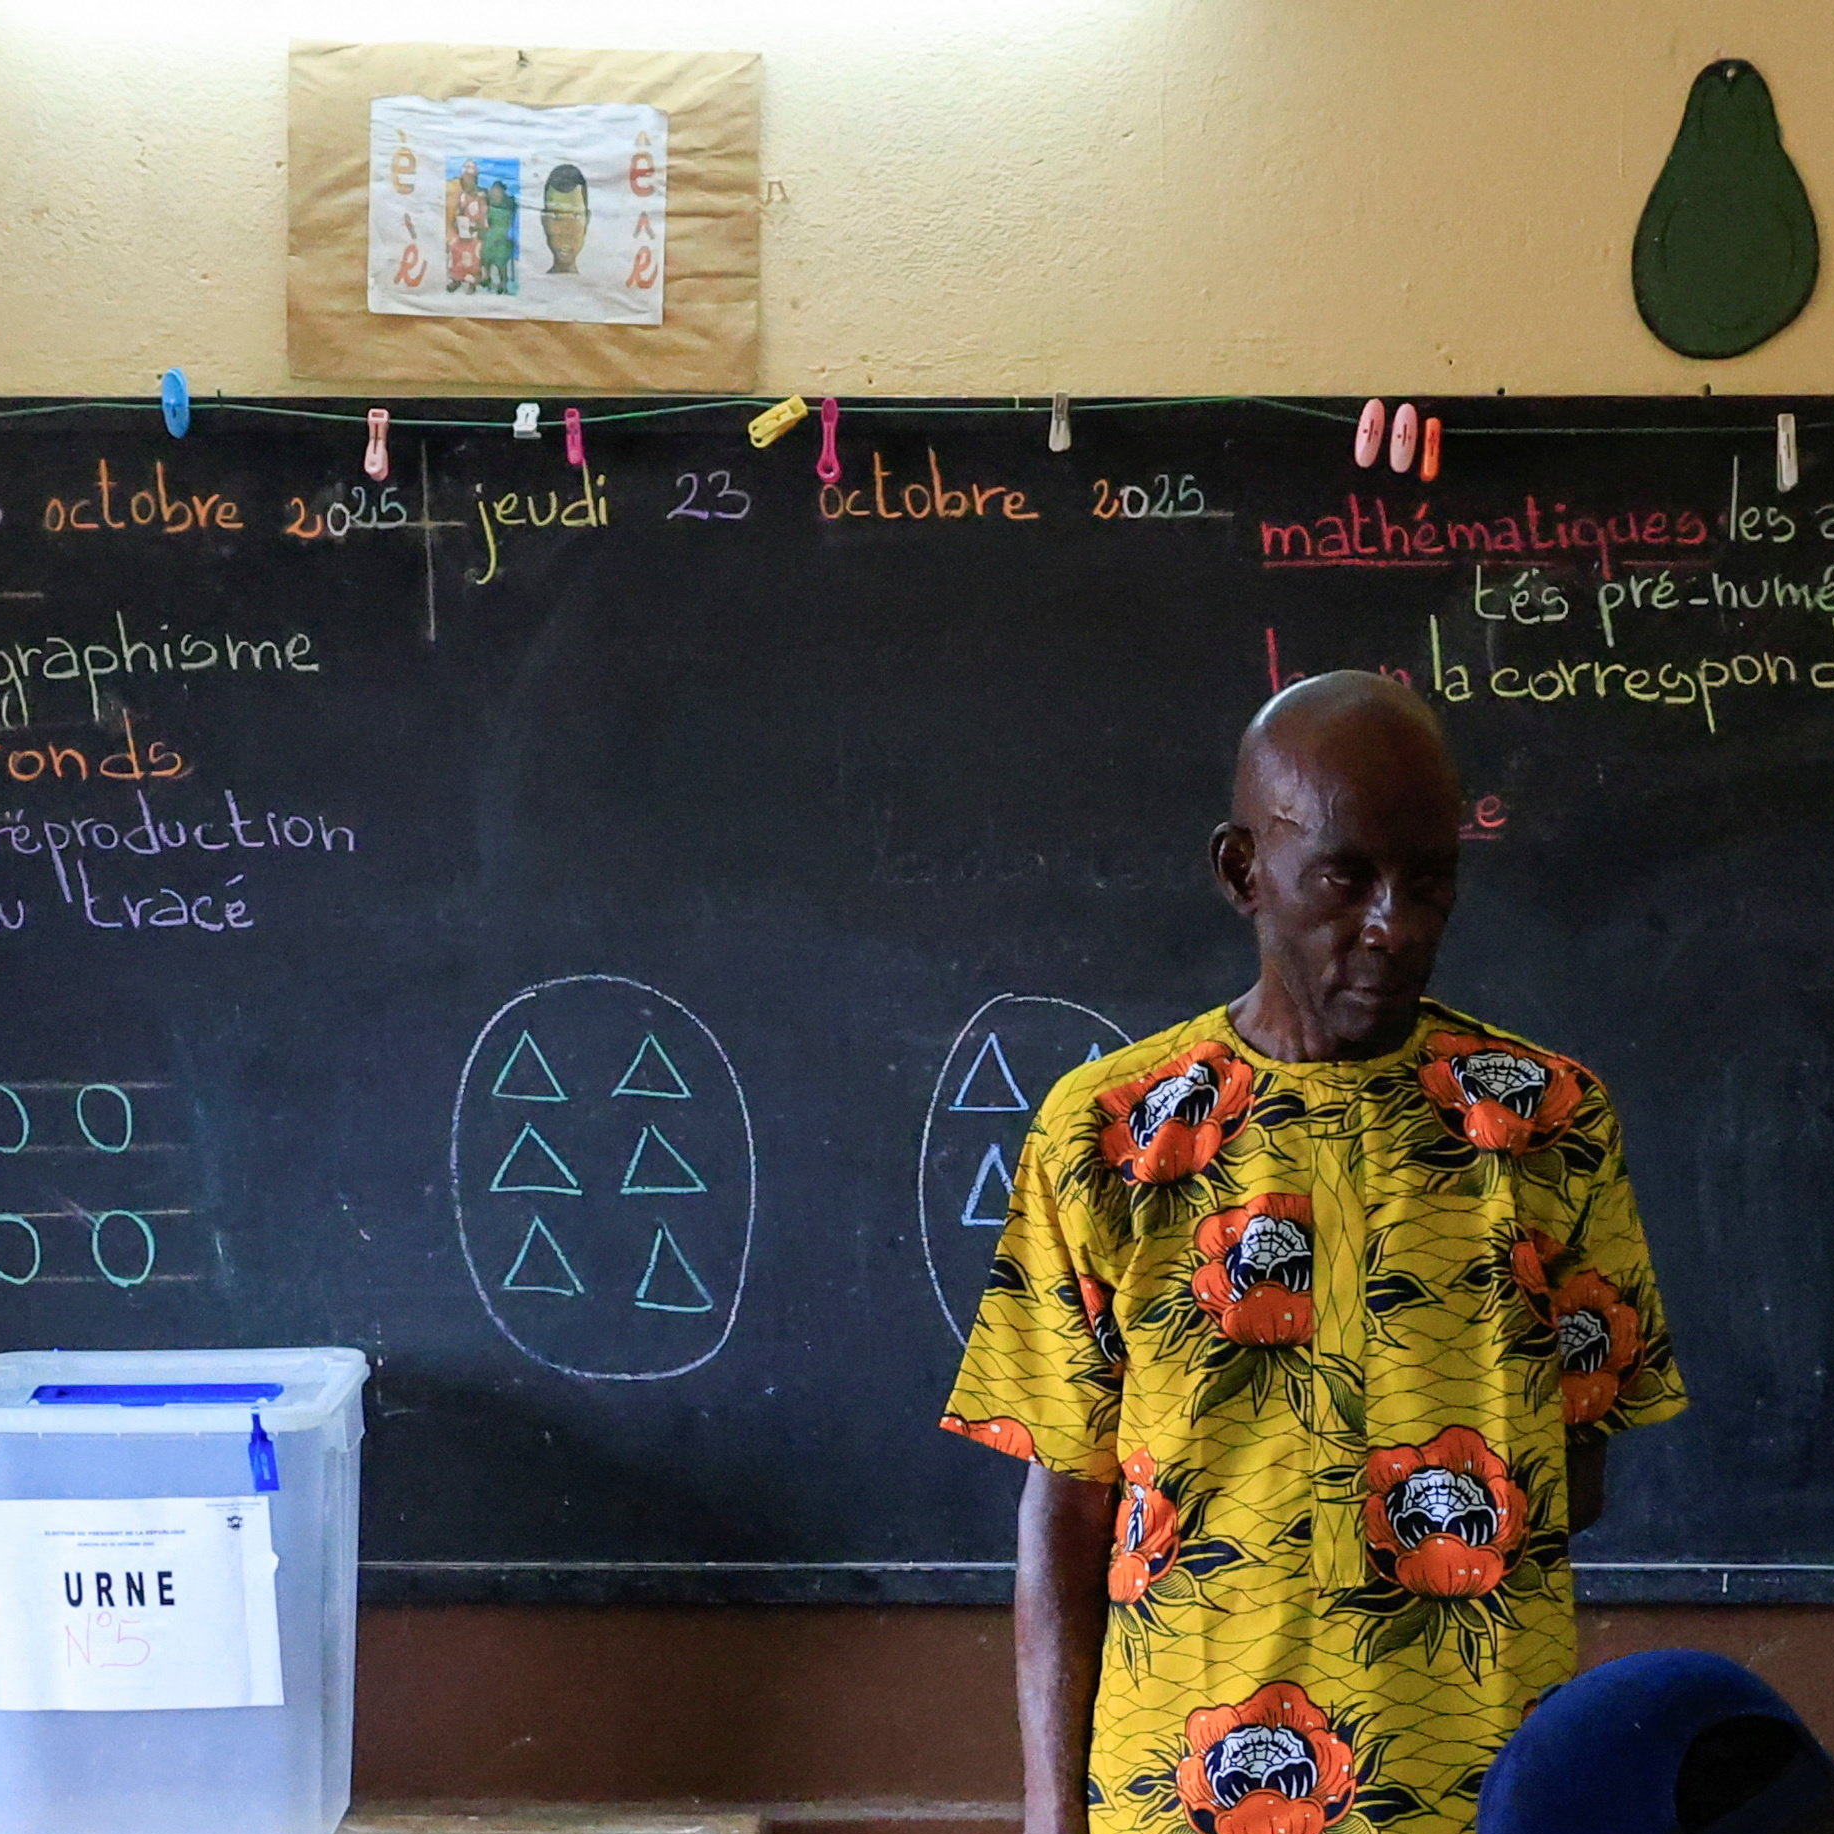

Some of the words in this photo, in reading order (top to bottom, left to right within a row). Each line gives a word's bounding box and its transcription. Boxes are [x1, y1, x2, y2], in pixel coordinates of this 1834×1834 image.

[45, 458, 244, 534] octobre
[286, 484, 408, 539] 2025
[473, 454, 609, 585] jeudi
[666, 470, 751, 522] 23
[819, 446, 1040, 522] octobre
[1092, 474, 1207, 519] 2025
[1728, 455, 1796, 547] les
[1429, 614, 1473, 702] la
[76, 859, 255, 930] tracé
[64, 1570, 176, 1608] URNE
